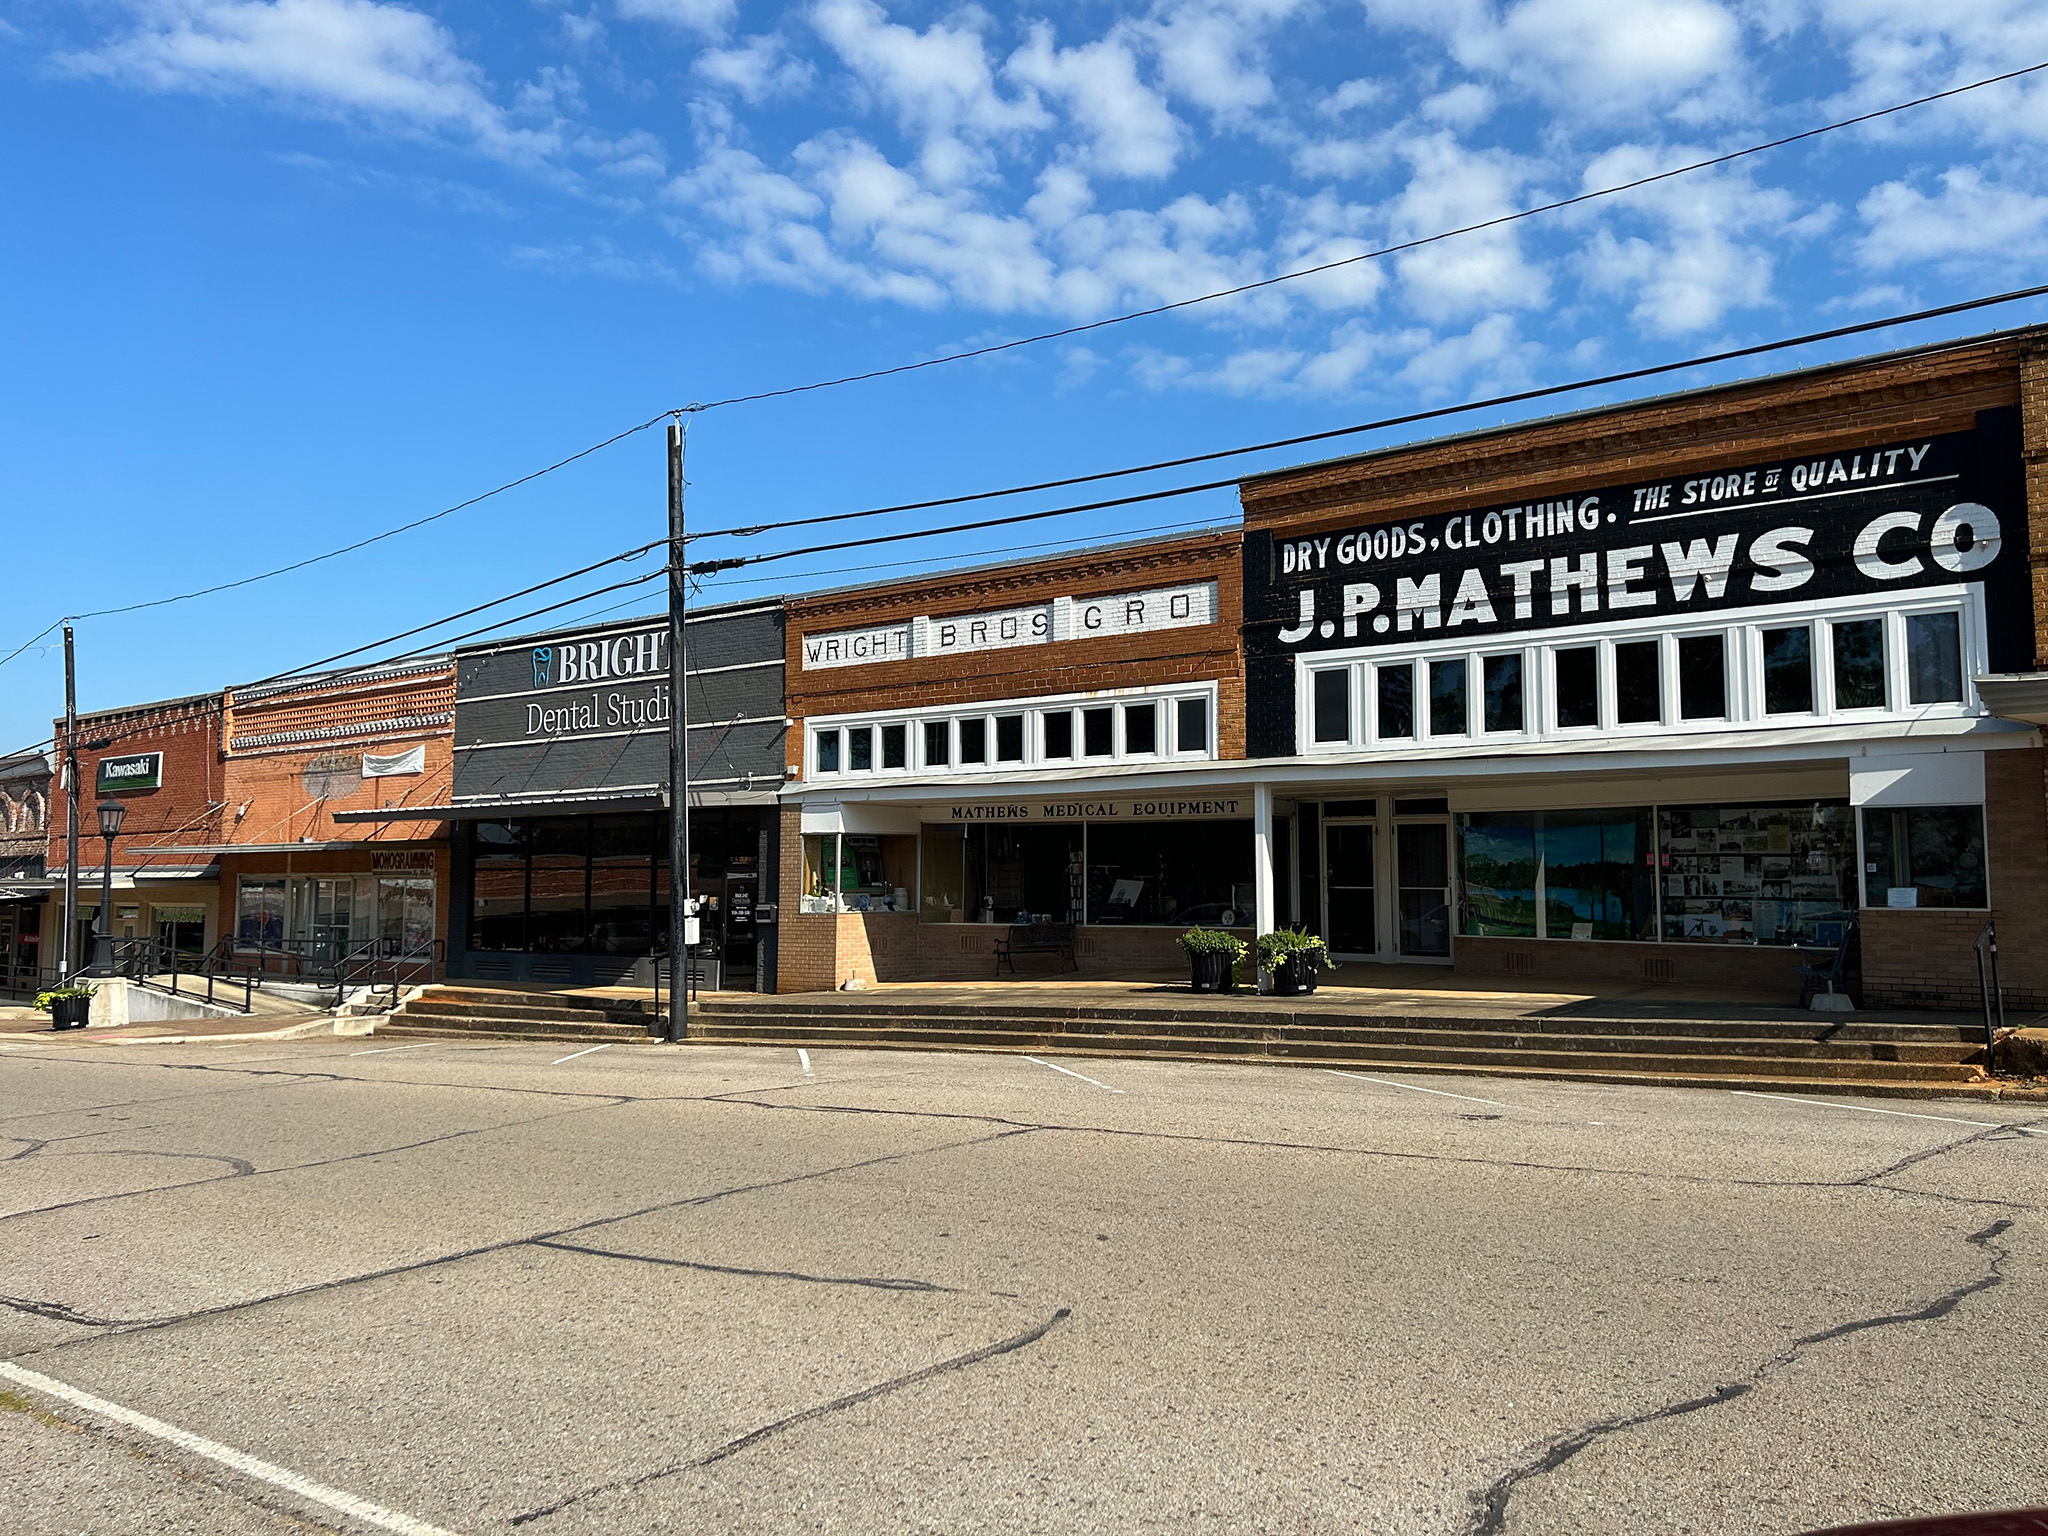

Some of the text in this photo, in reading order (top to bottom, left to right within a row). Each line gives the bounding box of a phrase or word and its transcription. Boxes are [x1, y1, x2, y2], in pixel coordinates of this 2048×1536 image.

[1633, 485, 1672, 513] THE
[1681, 471, 1757, 505] STORE
[1791, 444, 1932, 492] QUALITY
[1283, 536, 1331, 574] DRY
[1852, 502, 2001, 581] CO
[806, 594, 1190, 663] WRIGHT BROS GRO
[525, 685, 670, 736] Dental Studi
[105, 757, 150, 779] Kawasaki
[951, 800, 1239, 819] MATHEWS MEDICAL EQUIPMENT
[371, 851, 434, 870] MONOGRAMMING
